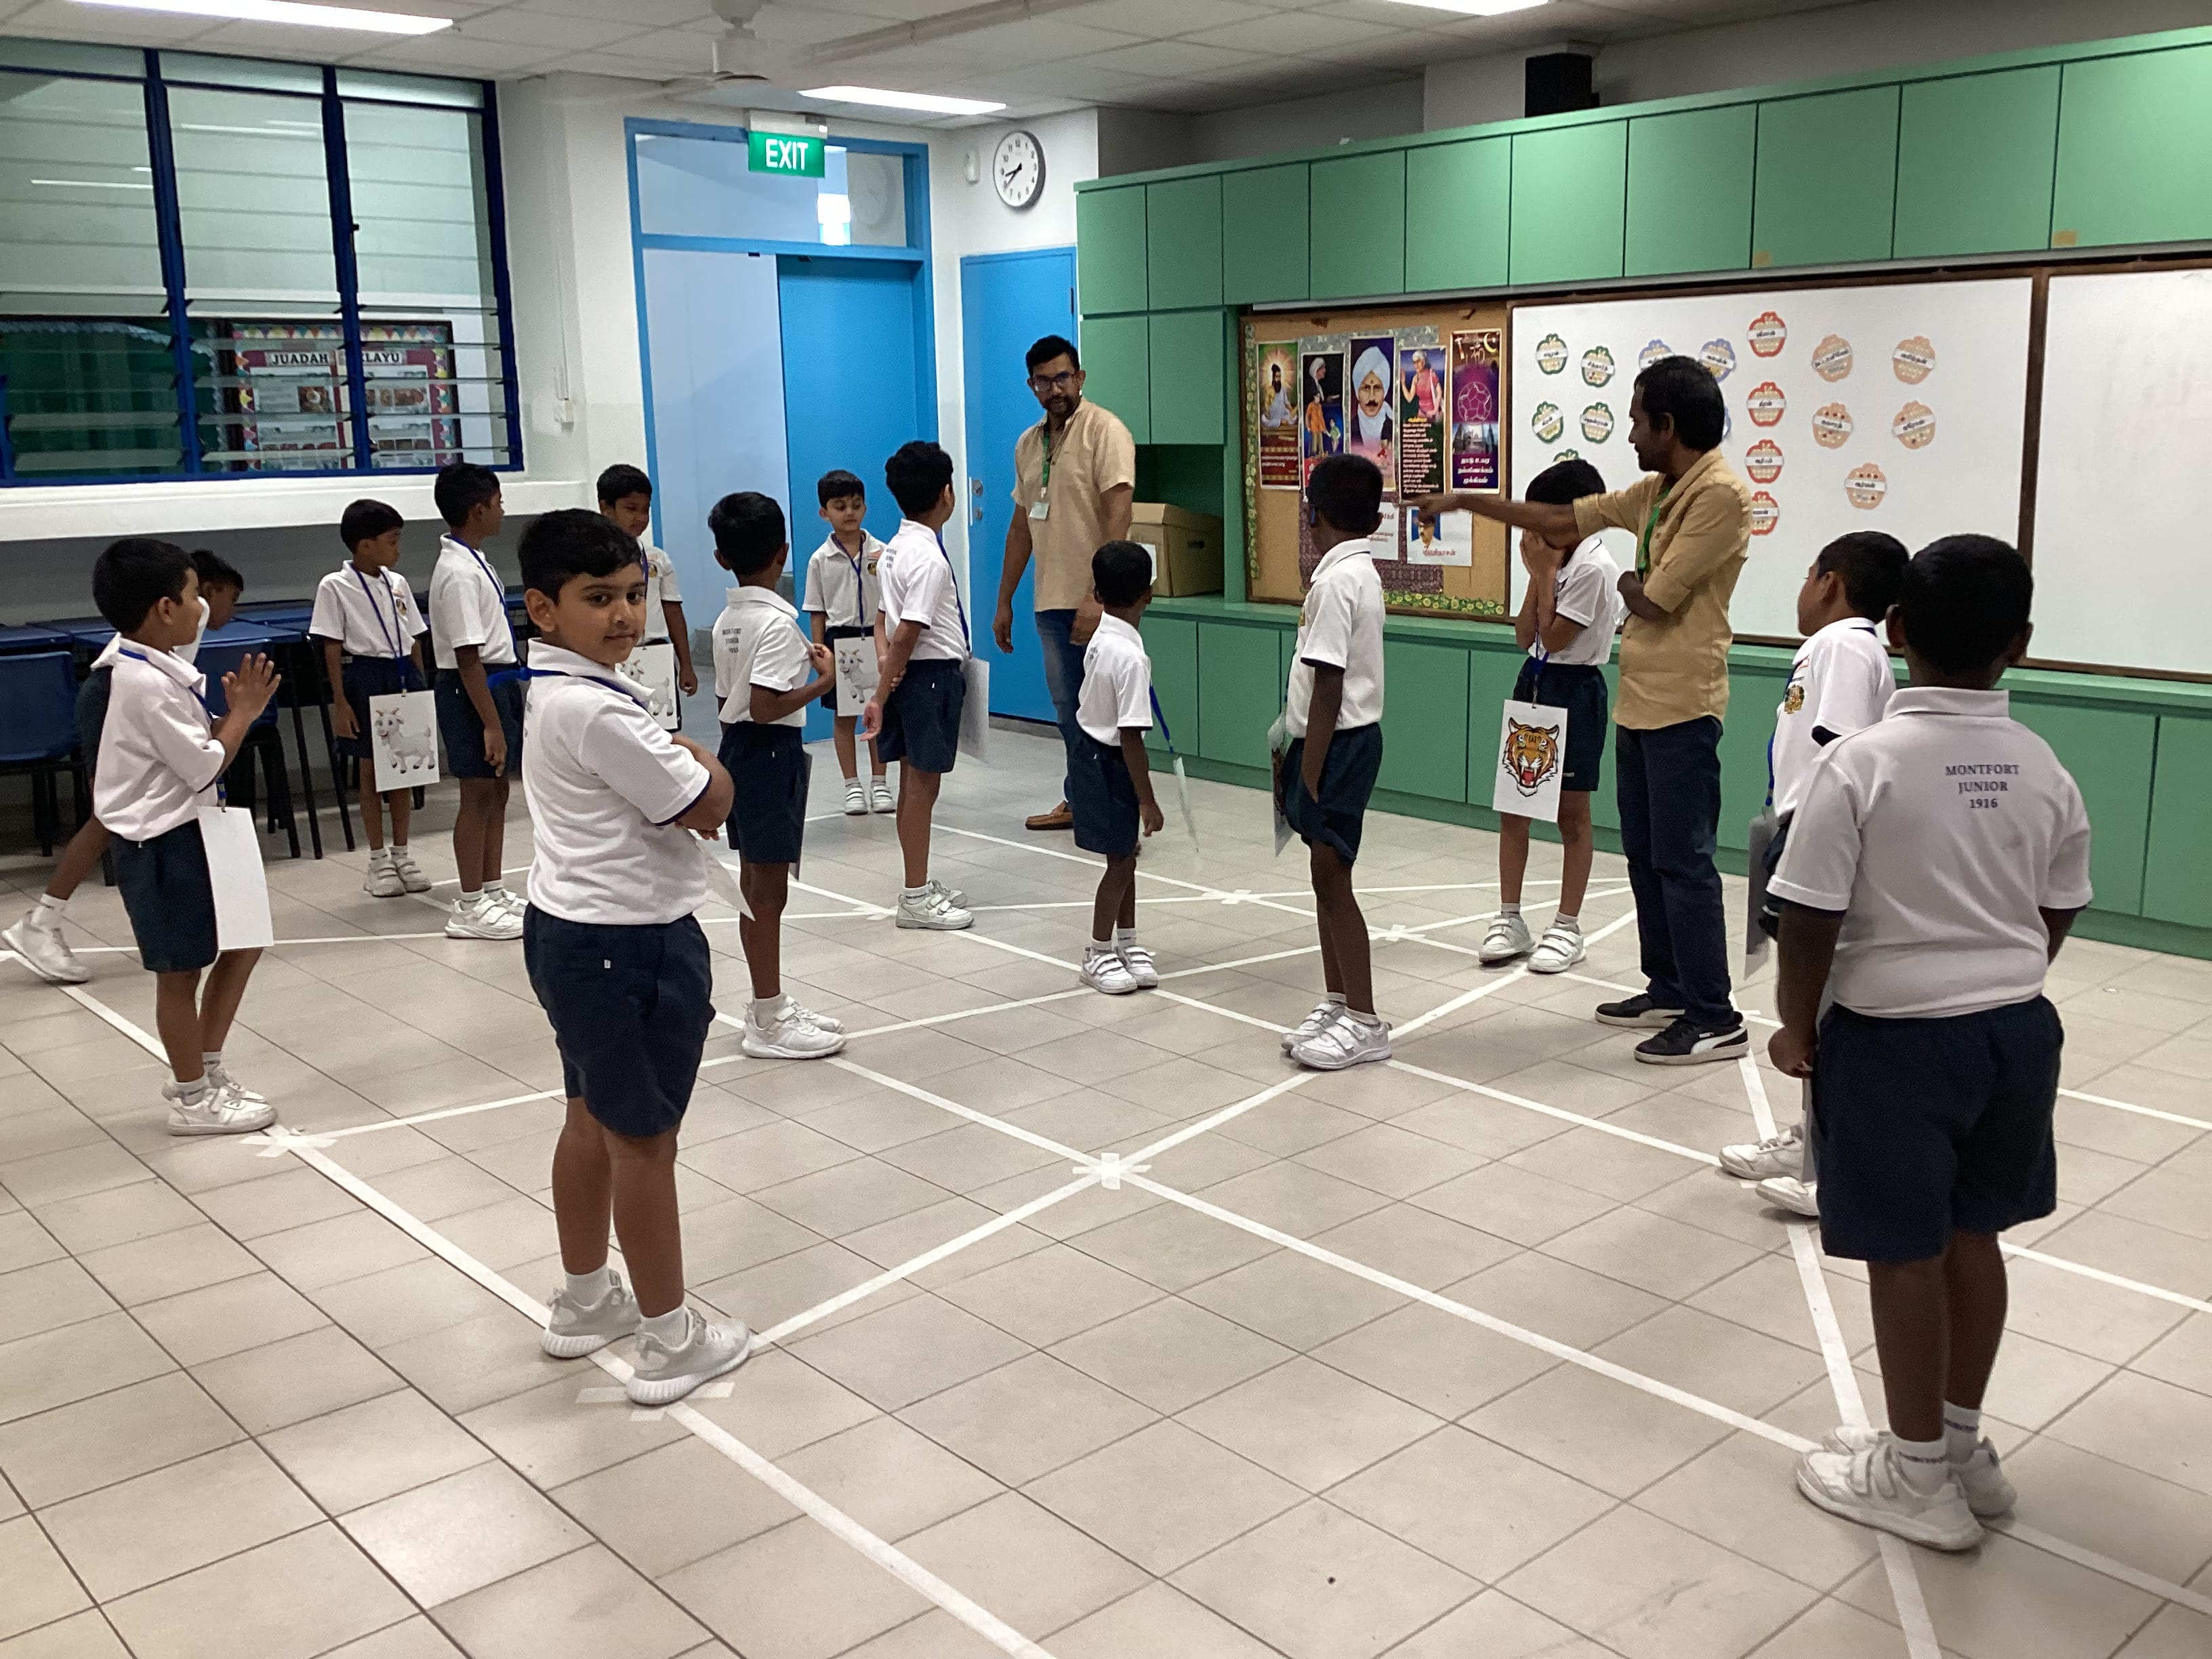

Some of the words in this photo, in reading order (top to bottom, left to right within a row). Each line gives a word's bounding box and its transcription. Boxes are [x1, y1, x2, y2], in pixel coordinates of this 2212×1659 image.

[765, 138, 809, 171] EXIT
[272, 354, 329, 365] JUADAH
[362, 352, 399, 363] LAYU
[1945, 764, 2020, 776] MONTFORT
[1958, 781, 2008, 795] JUNIOR
[1970, 798, 1998, 808] 1916
